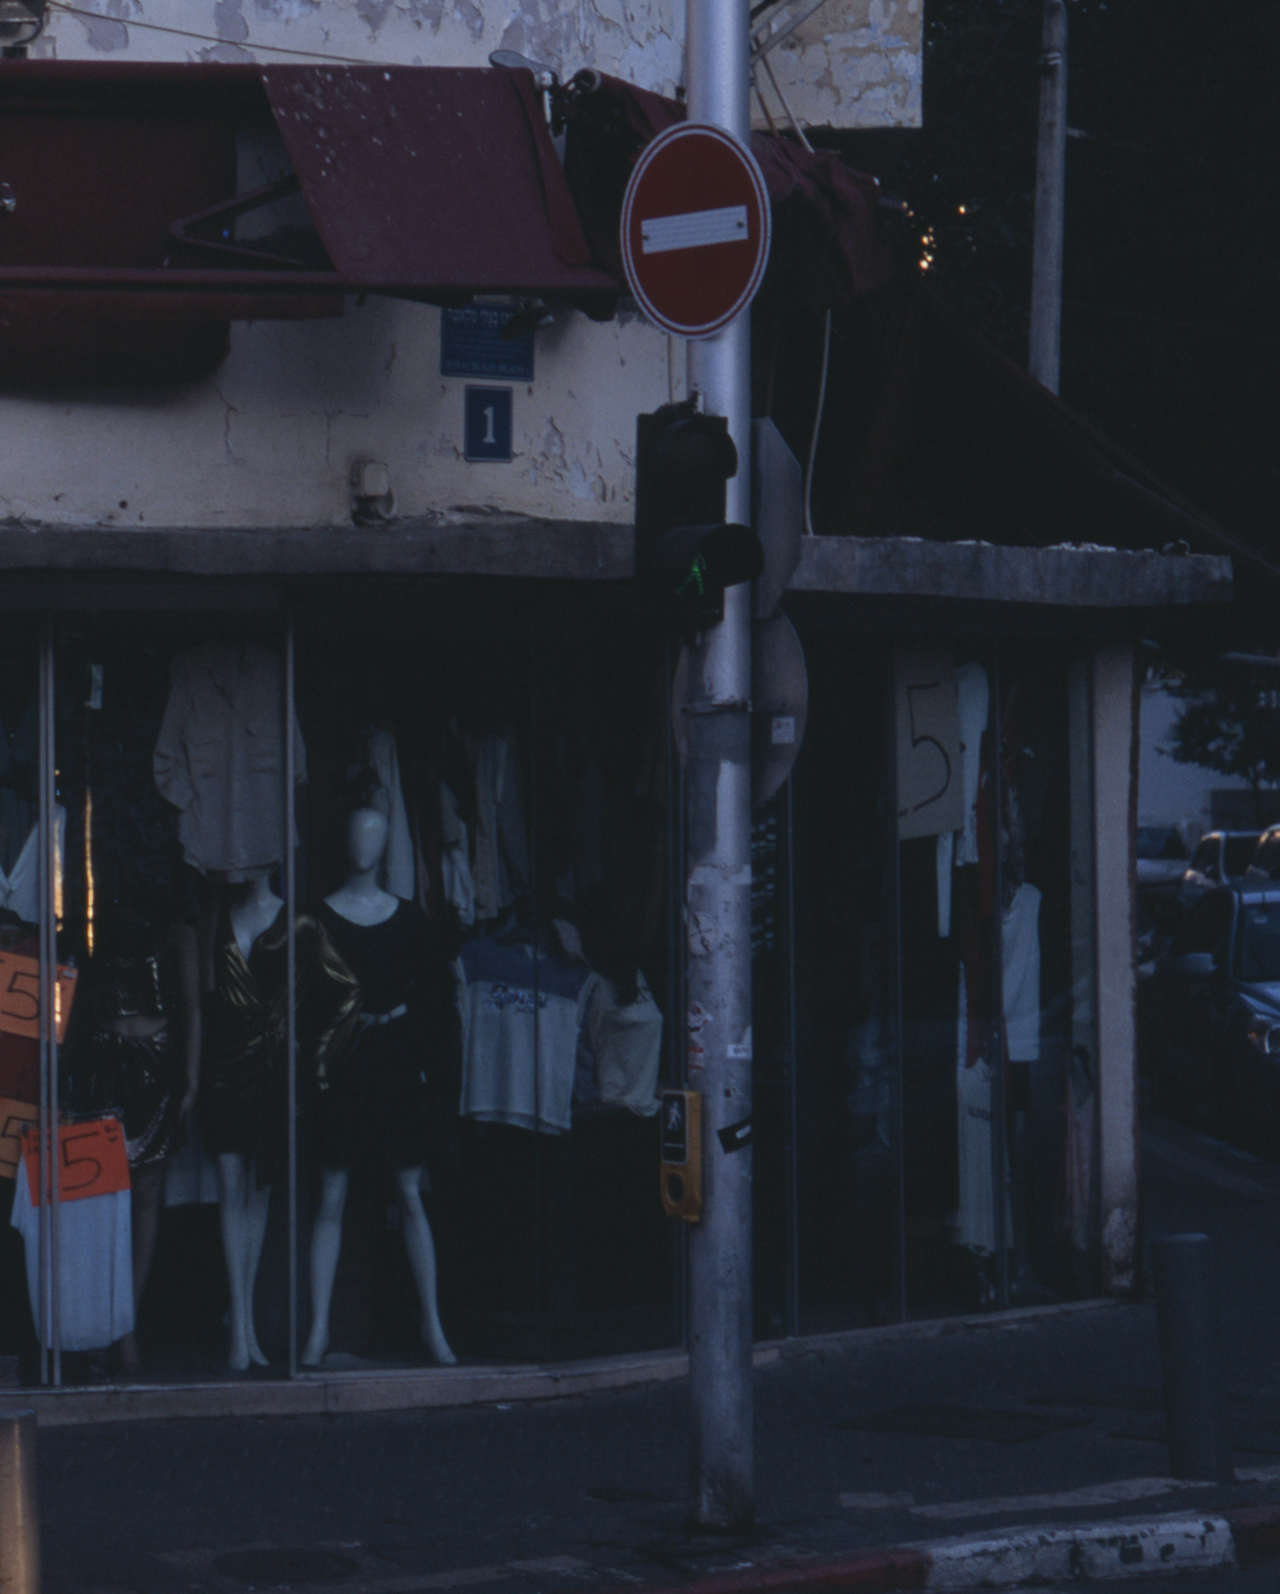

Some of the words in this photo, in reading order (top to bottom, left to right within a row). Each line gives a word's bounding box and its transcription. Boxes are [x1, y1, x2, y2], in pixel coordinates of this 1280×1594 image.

[482, 406, 496, 443] 1
[906, 682, 951, 811] 5
[0, 971, 41, 1021] 5
[61, 1130, 102, 1192] 5
